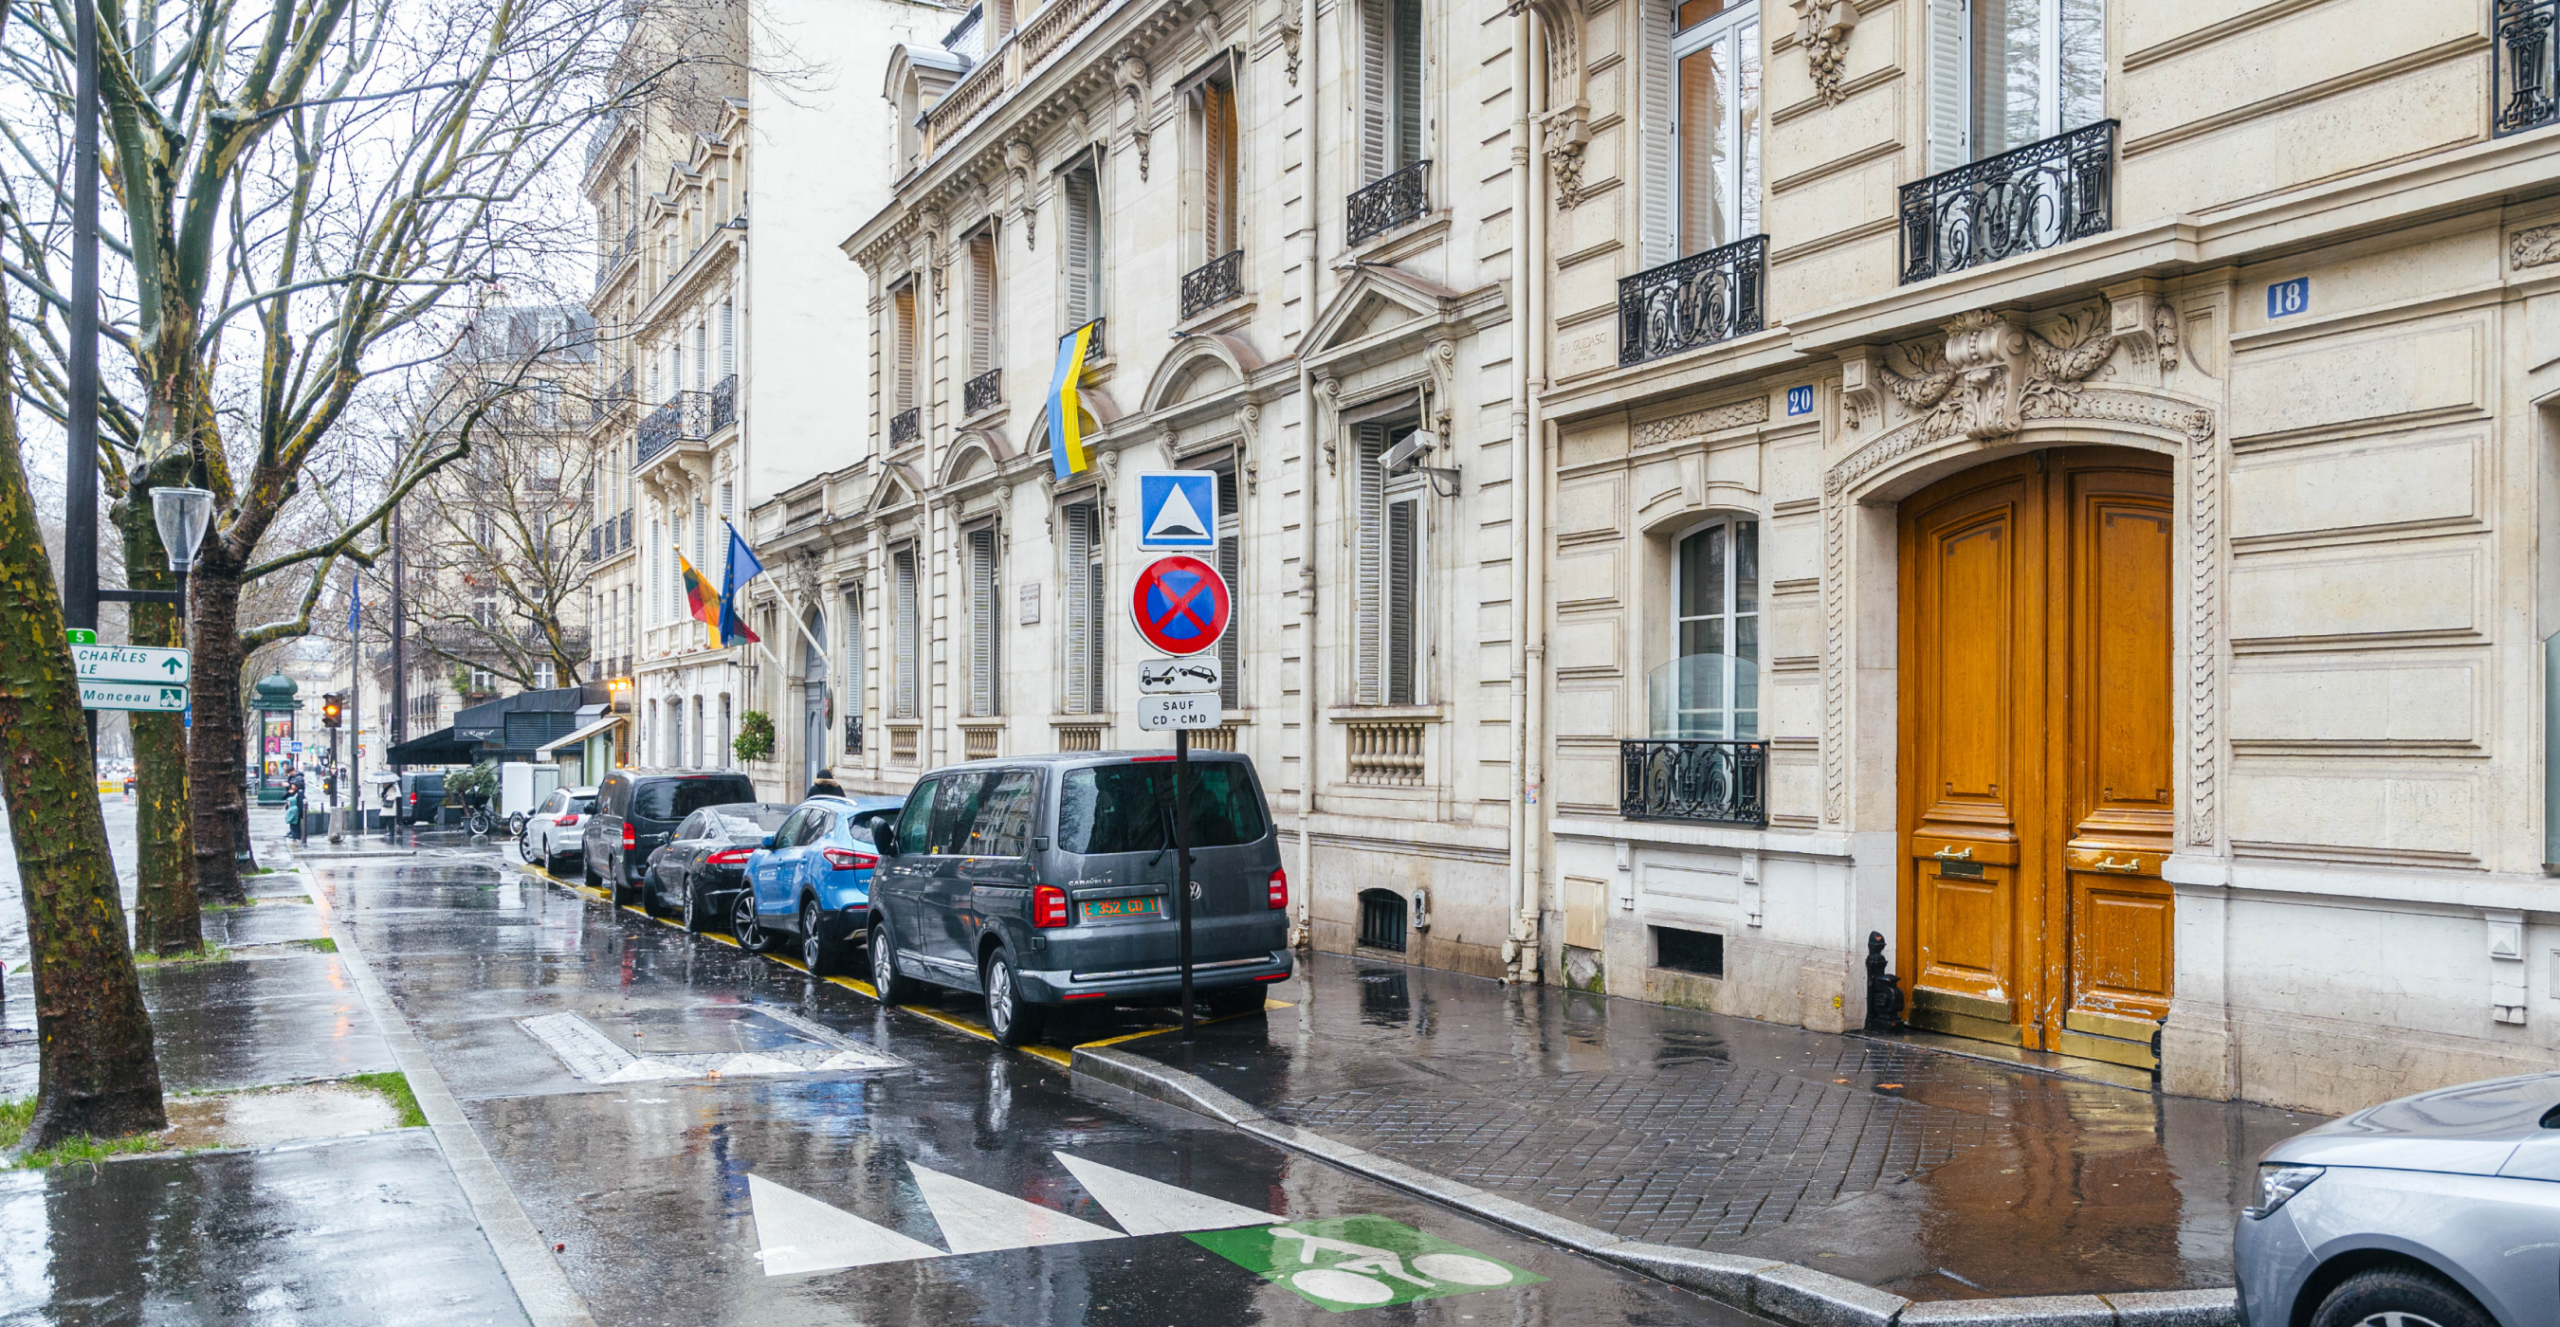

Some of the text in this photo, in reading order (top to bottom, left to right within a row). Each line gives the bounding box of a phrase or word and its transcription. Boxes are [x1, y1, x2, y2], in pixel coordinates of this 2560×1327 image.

[2274, 282, 2301, 315] 18
[1790, 388, 1811, 414] 20
[76, 632, 84, 642] 5
[79, 650, 147, 663] CHARLES
[76, 664, 97, 674] LE
[83, 690, 151, 702] Monceau
[1162, 700, 1194, 711] SAUF
[1152, 715, 1168, 725] CD
[1180, 714, 1206, 724] CMD
[1084, 898, 1155, 915] E 352 CD 1
